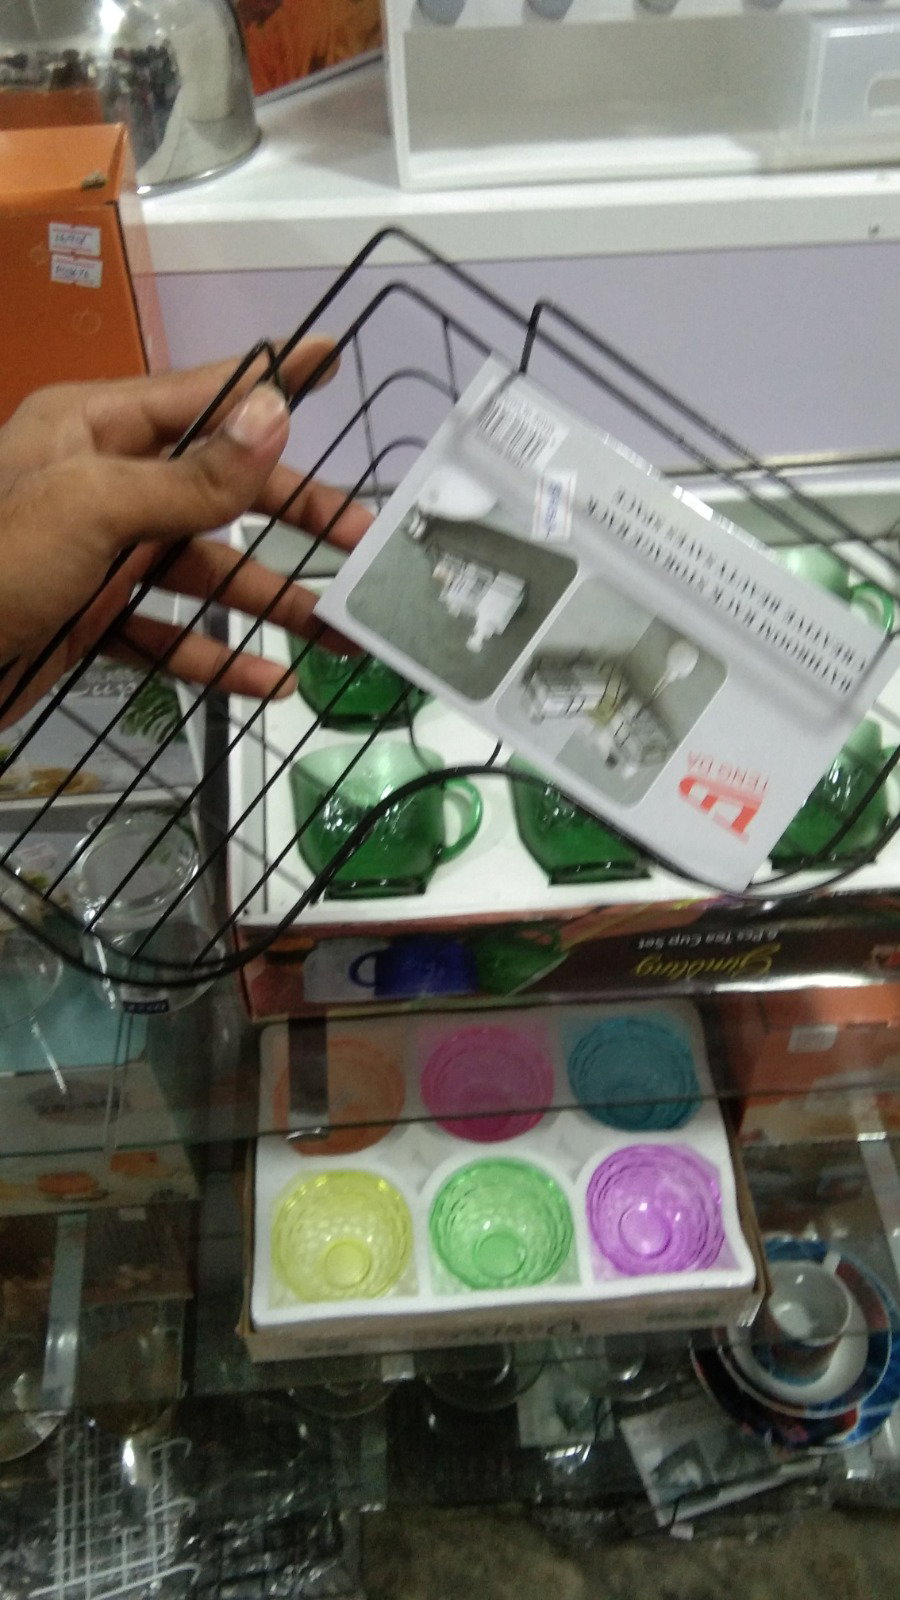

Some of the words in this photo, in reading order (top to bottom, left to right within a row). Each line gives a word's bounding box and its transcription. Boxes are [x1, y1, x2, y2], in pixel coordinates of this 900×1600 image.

[586, 496, 633, 541] RACK
[613, 489, 663, 532] SPACE
[632, 532, 708, 593] STORAGE
[663, 524, 715, 567] SAVES
[711, 585, 756, 627] RACK
[717, 561, 781, 613] BEAUTY
[758, 619, 853, 692] BATHROOM
